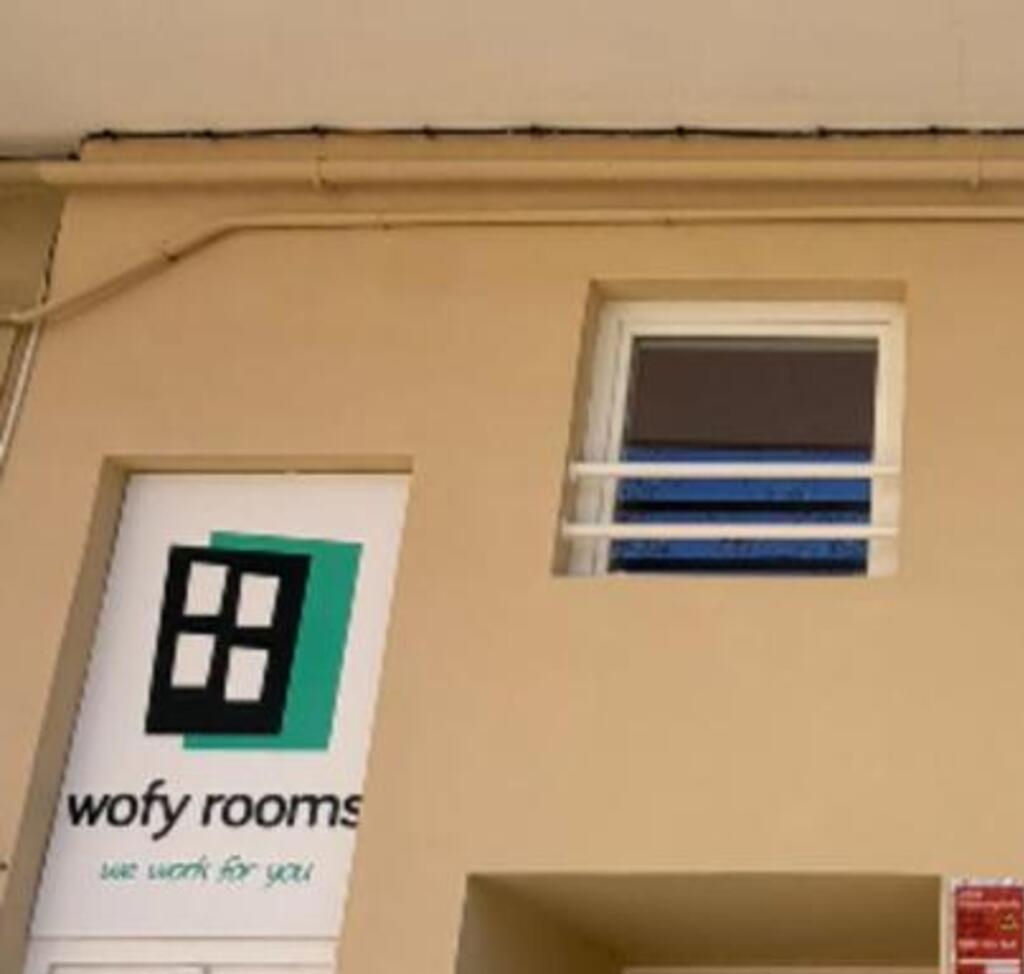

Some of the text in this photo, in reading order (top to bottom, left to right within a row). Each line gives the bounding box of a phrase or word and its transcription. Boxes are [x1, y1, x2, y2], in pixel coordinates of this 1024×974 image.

[67, 779, 362, 841] wofy rooms
[99, 855, 315, 888] we work for you
